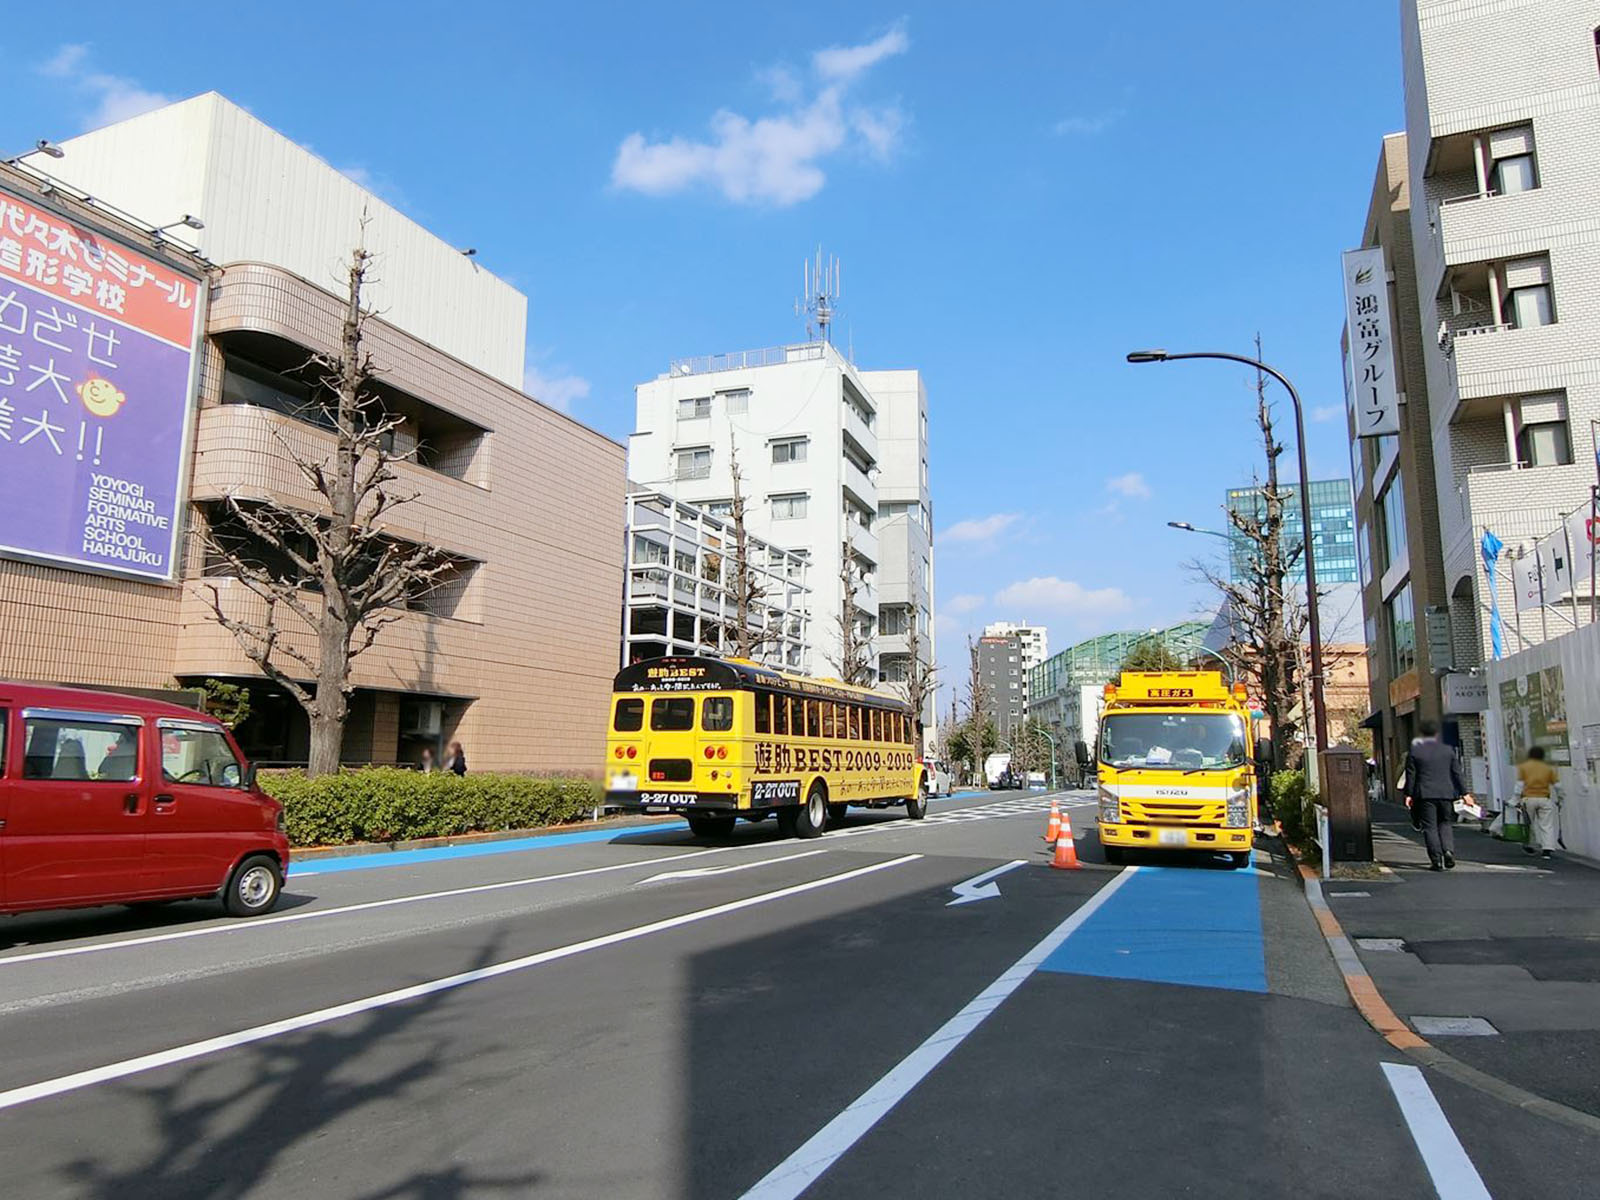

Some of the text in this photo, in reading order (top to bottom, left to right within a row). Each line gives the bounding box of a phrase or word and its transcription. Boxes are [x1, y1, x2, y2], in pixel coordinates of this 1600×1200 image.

[90, 472, 144, 498] YOYOGI
[88, 486, 155, 513] SEMINAR
[84, 513, 126, 533] ARTS
[87, 499, 169, 530] FORMATIVE
[83, 526, 146, 552] SCHOOL
[82, 539, 163, 567] HARAJUKU
